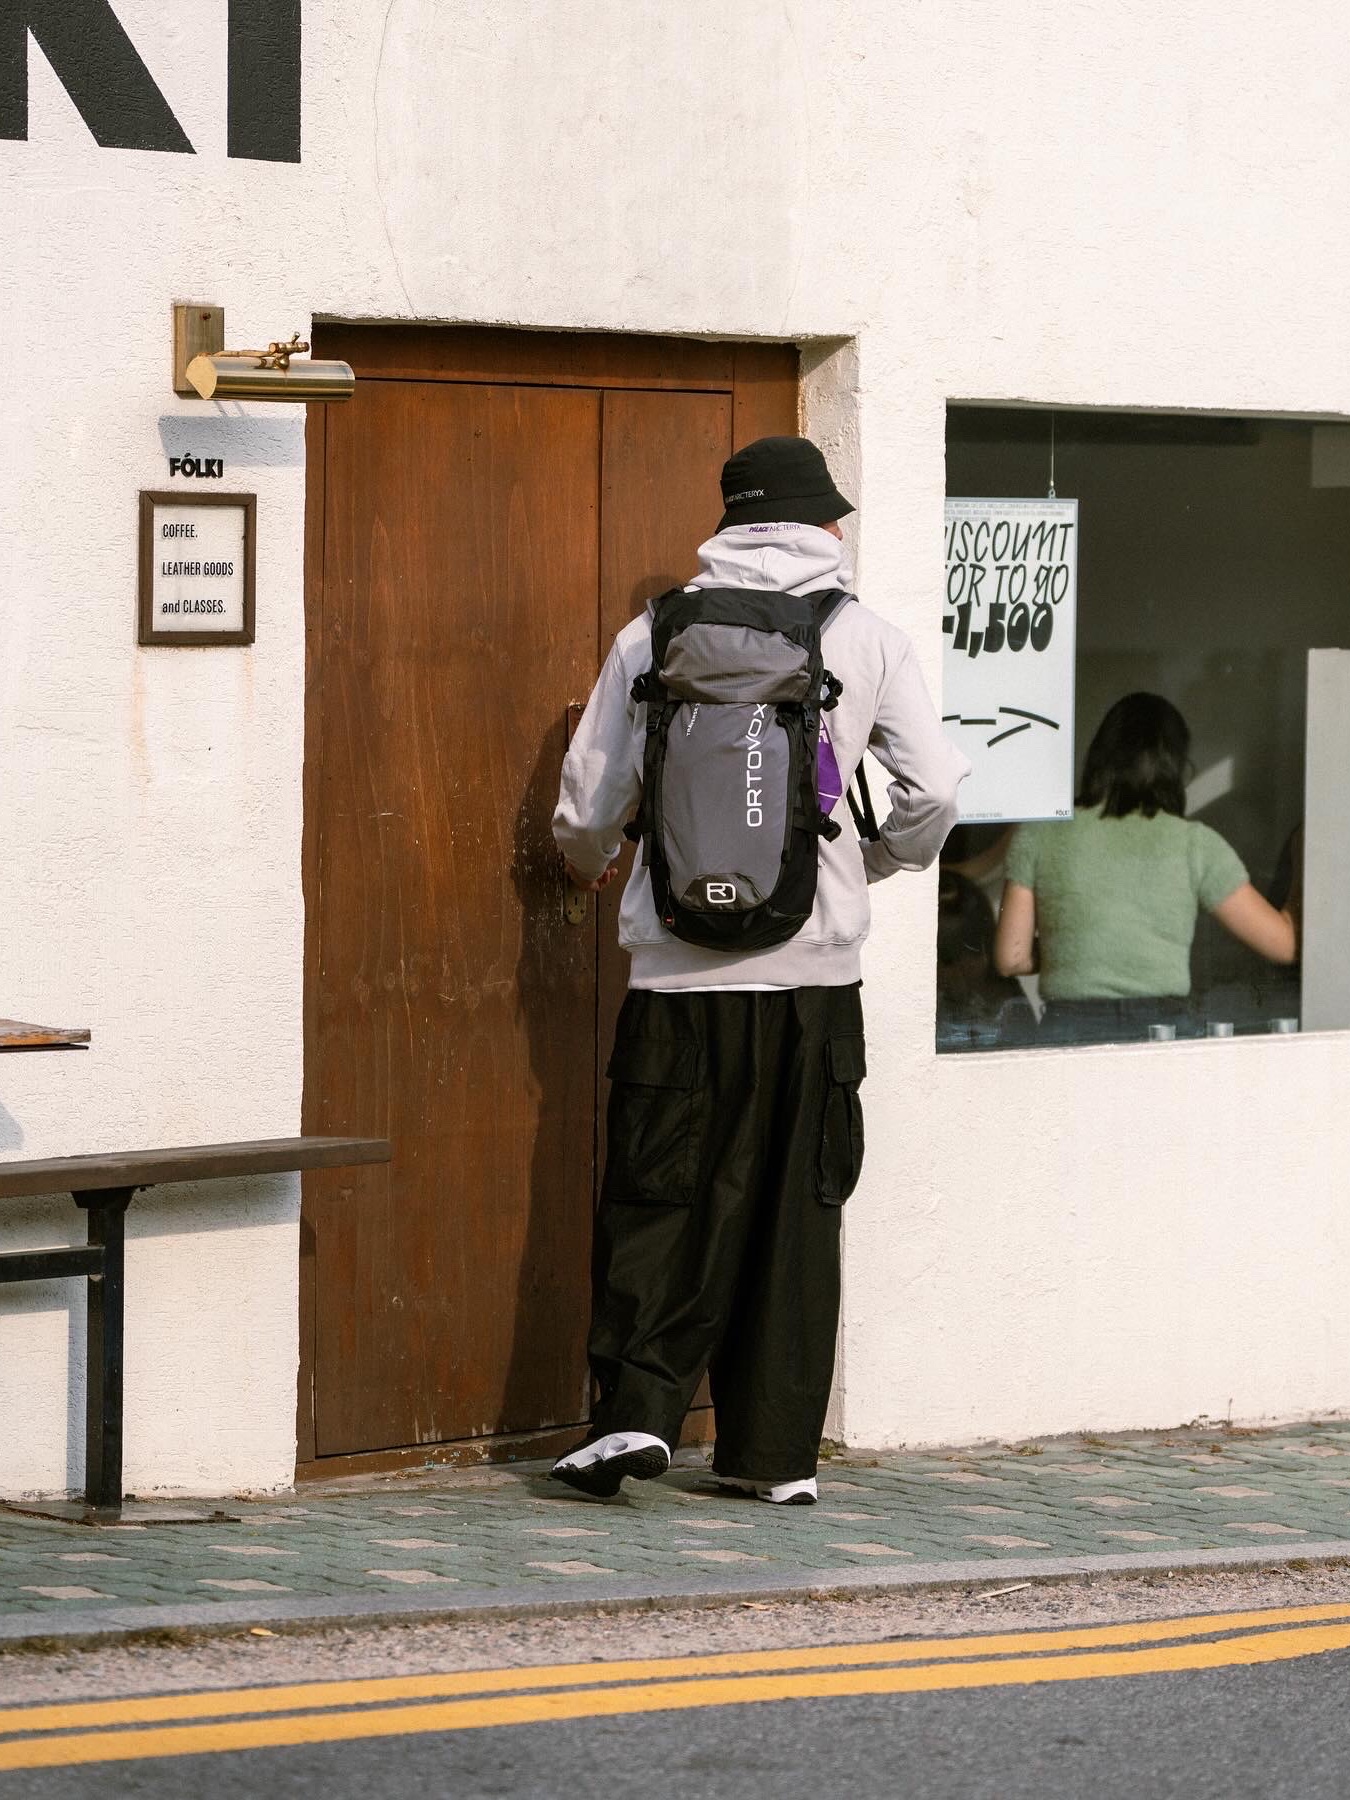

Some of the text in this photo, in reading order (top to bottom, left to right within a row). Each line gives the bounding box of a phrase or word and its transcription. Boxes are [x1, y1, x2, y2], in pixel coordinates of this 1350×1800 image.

[169, 452, 224, 478] FÓLKI
[162, 523, 198, 538] COFFEE.
[945, 520, 1074, 562] ISCOUNT
[162, 561, 234, 576] LEATHER GOODS
[945, 563, 987, 608] OR
[995, 563, 1027, 605] TO
[162, 599, 226, 613] and CLASSES.
[746, 703, 768, 827] ORTOVOX
